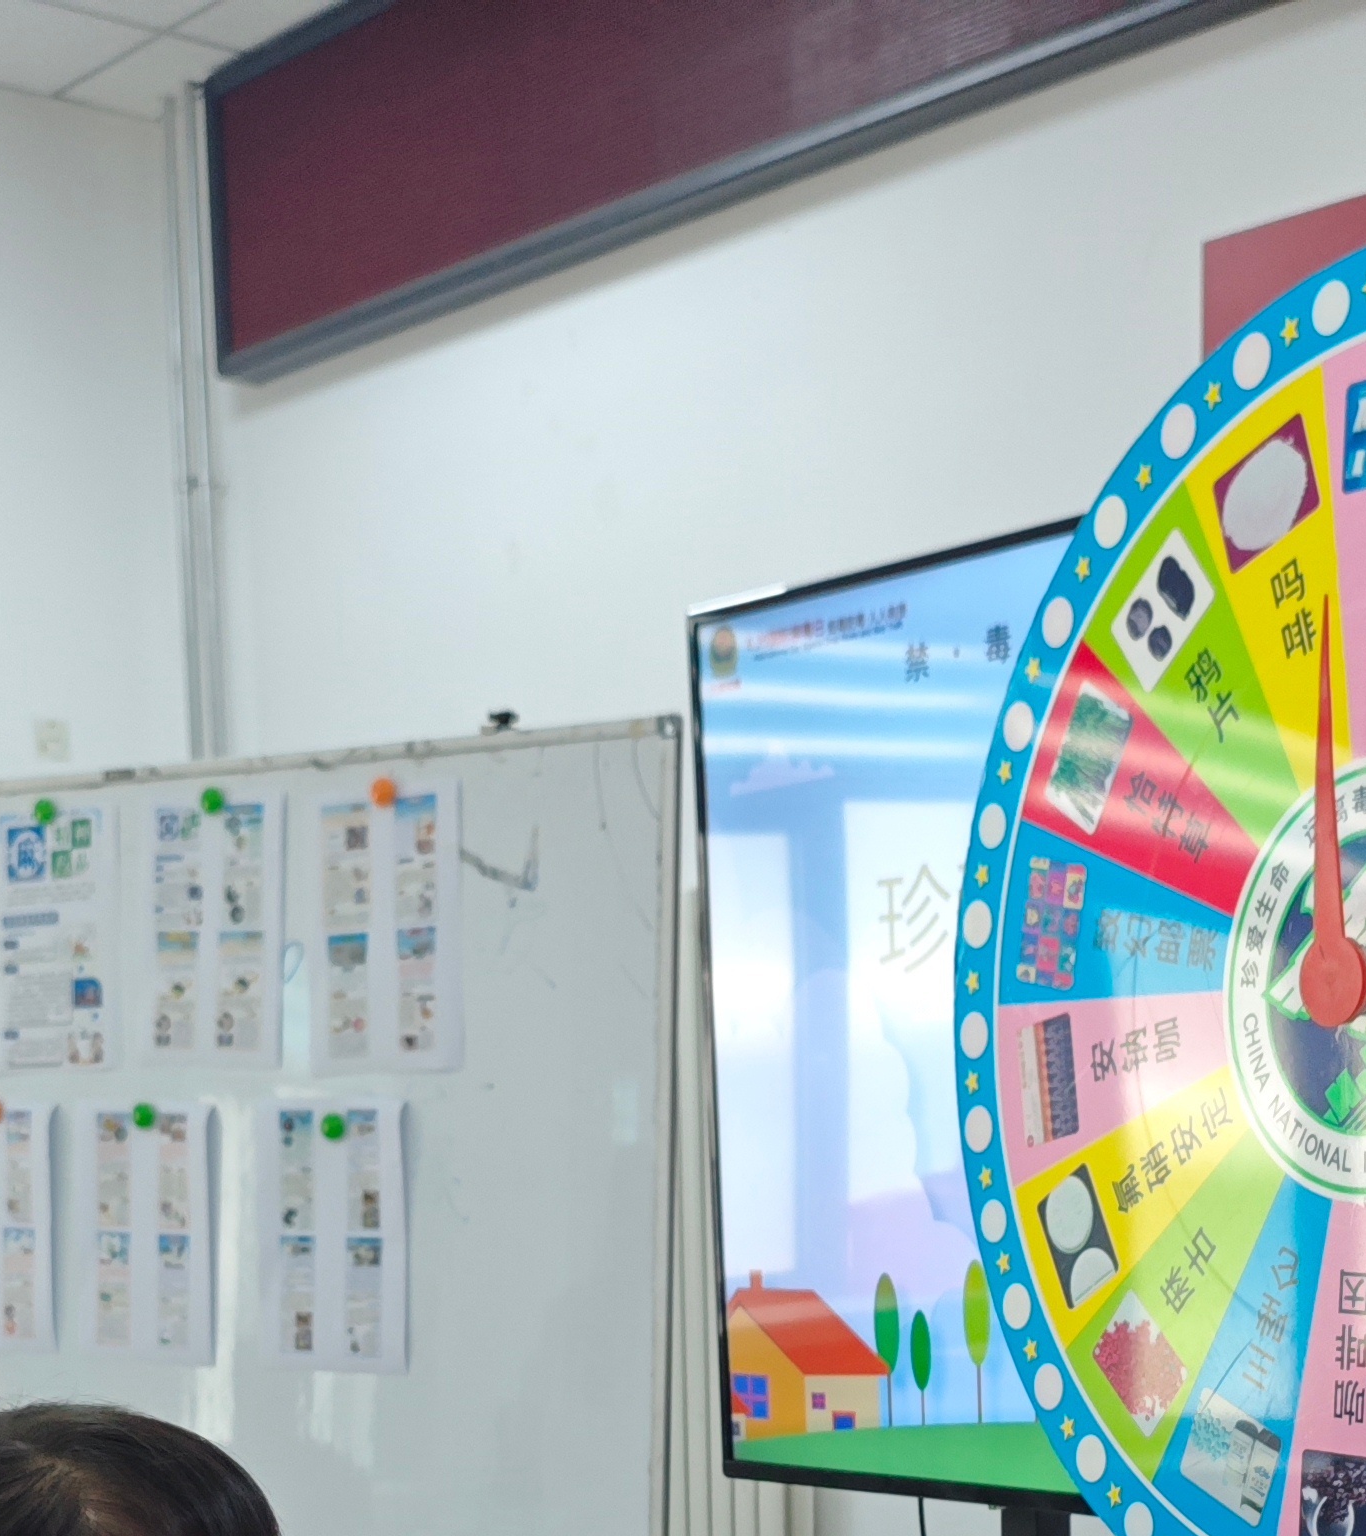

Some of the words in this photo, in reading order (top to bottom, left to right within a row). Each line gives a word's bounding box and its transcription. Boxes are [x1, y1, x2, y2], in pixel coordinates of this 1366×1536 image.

[1270, 557, 1317, 659] 吗啡
[1184, 646, 1239, 743] 鸦片
[1241, 861, 1290, 989] 珍爱生命
[1090, 1016, 1181, 1082] 安钠咖
[1243, 1013, 1269, 1094] CHINA
[1269, 1095, 1352, 1173] NATIONAL
[1111, 1087, 1234, 1213] 氟硝安定
[1159, 1226, 1217, 1315] 麻古
